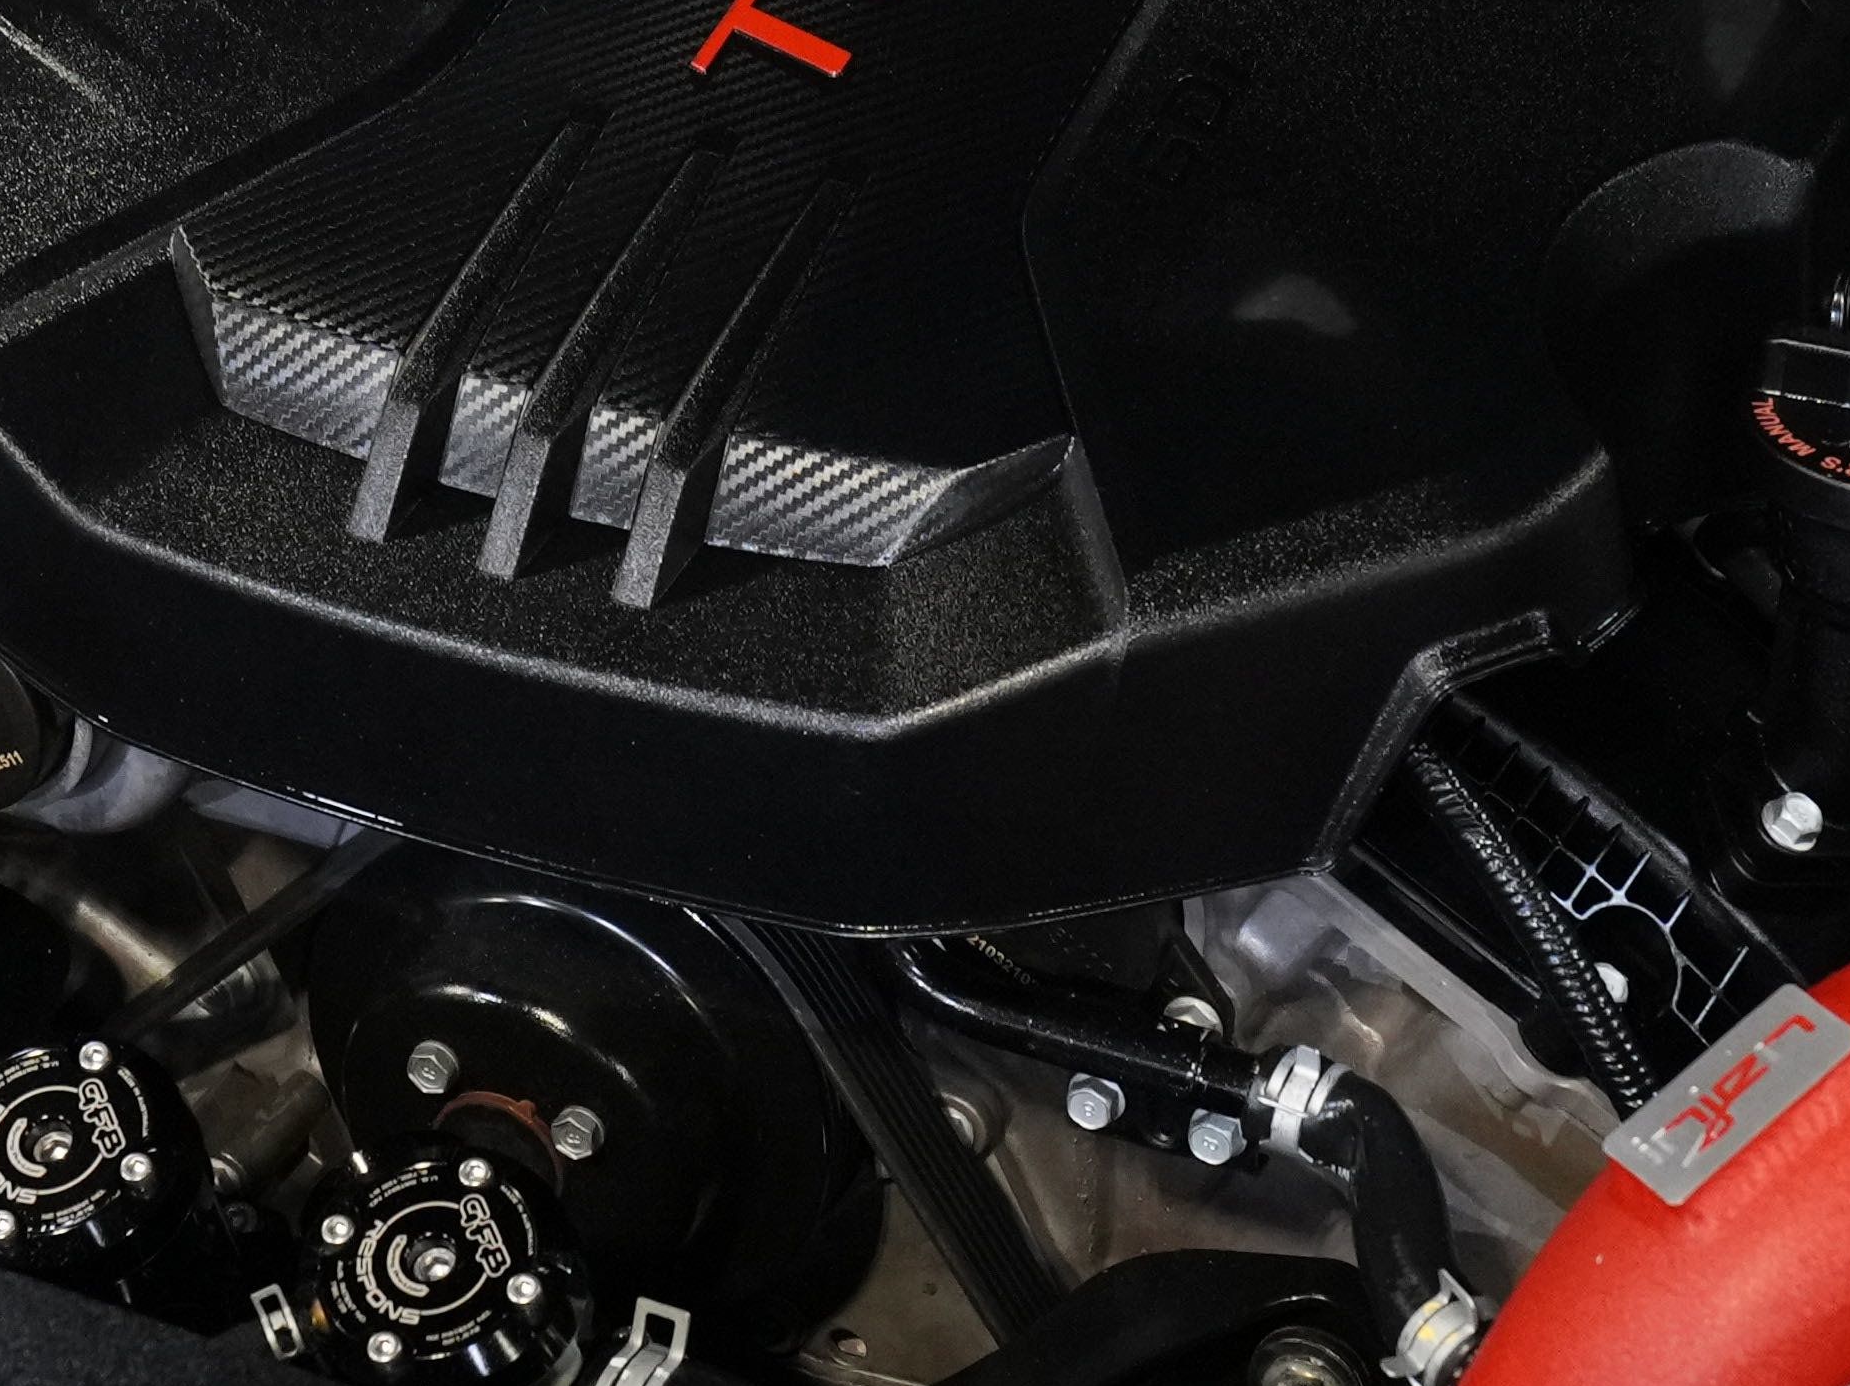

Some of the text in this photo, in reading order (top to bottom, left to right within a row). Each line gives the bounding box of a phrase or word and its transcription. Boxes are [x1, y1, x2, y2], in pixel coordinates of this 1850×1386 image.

[1751, 397, 1817, 457] MANUAL
[965, 933, 1037, 986] 2103210
[78, 1077, 126, 1159] GFB
[355, 1218, 422, 1326] RESPONS
[459, 1192, 512, 1278] GFB
